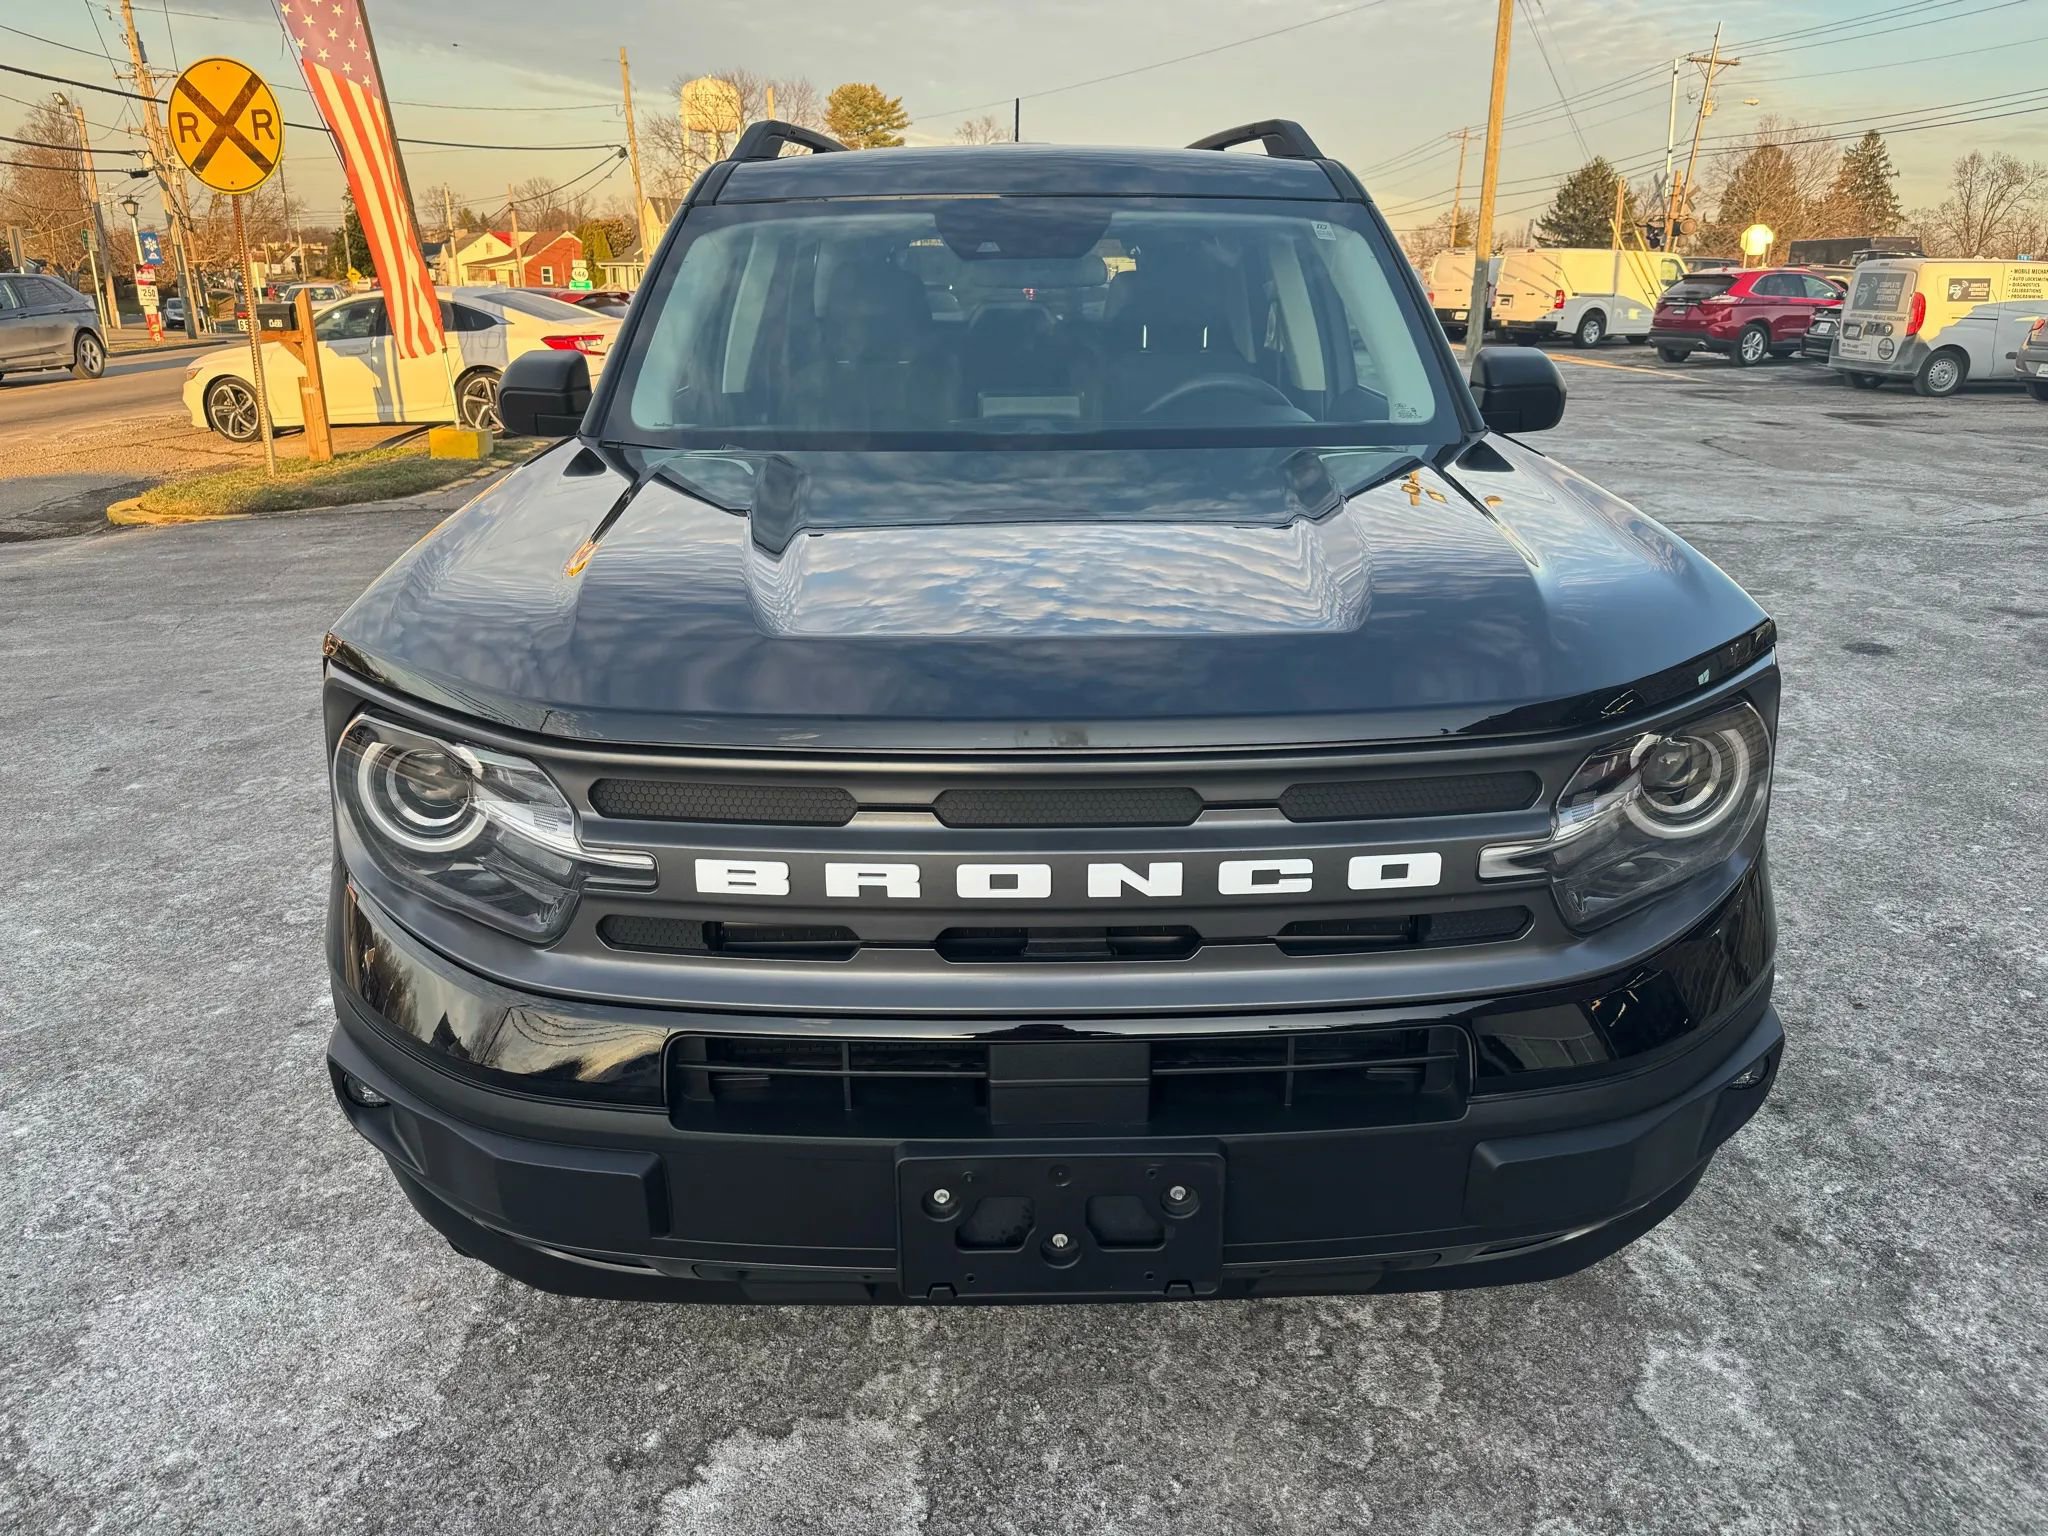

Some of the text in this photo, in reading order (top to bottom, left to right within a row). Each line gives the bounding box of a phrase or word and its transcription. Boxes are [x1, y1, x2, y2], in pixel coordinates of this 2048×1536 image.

[177, 109, 275, 143] R R
[694, 852, 1442, 898] BRONCO
